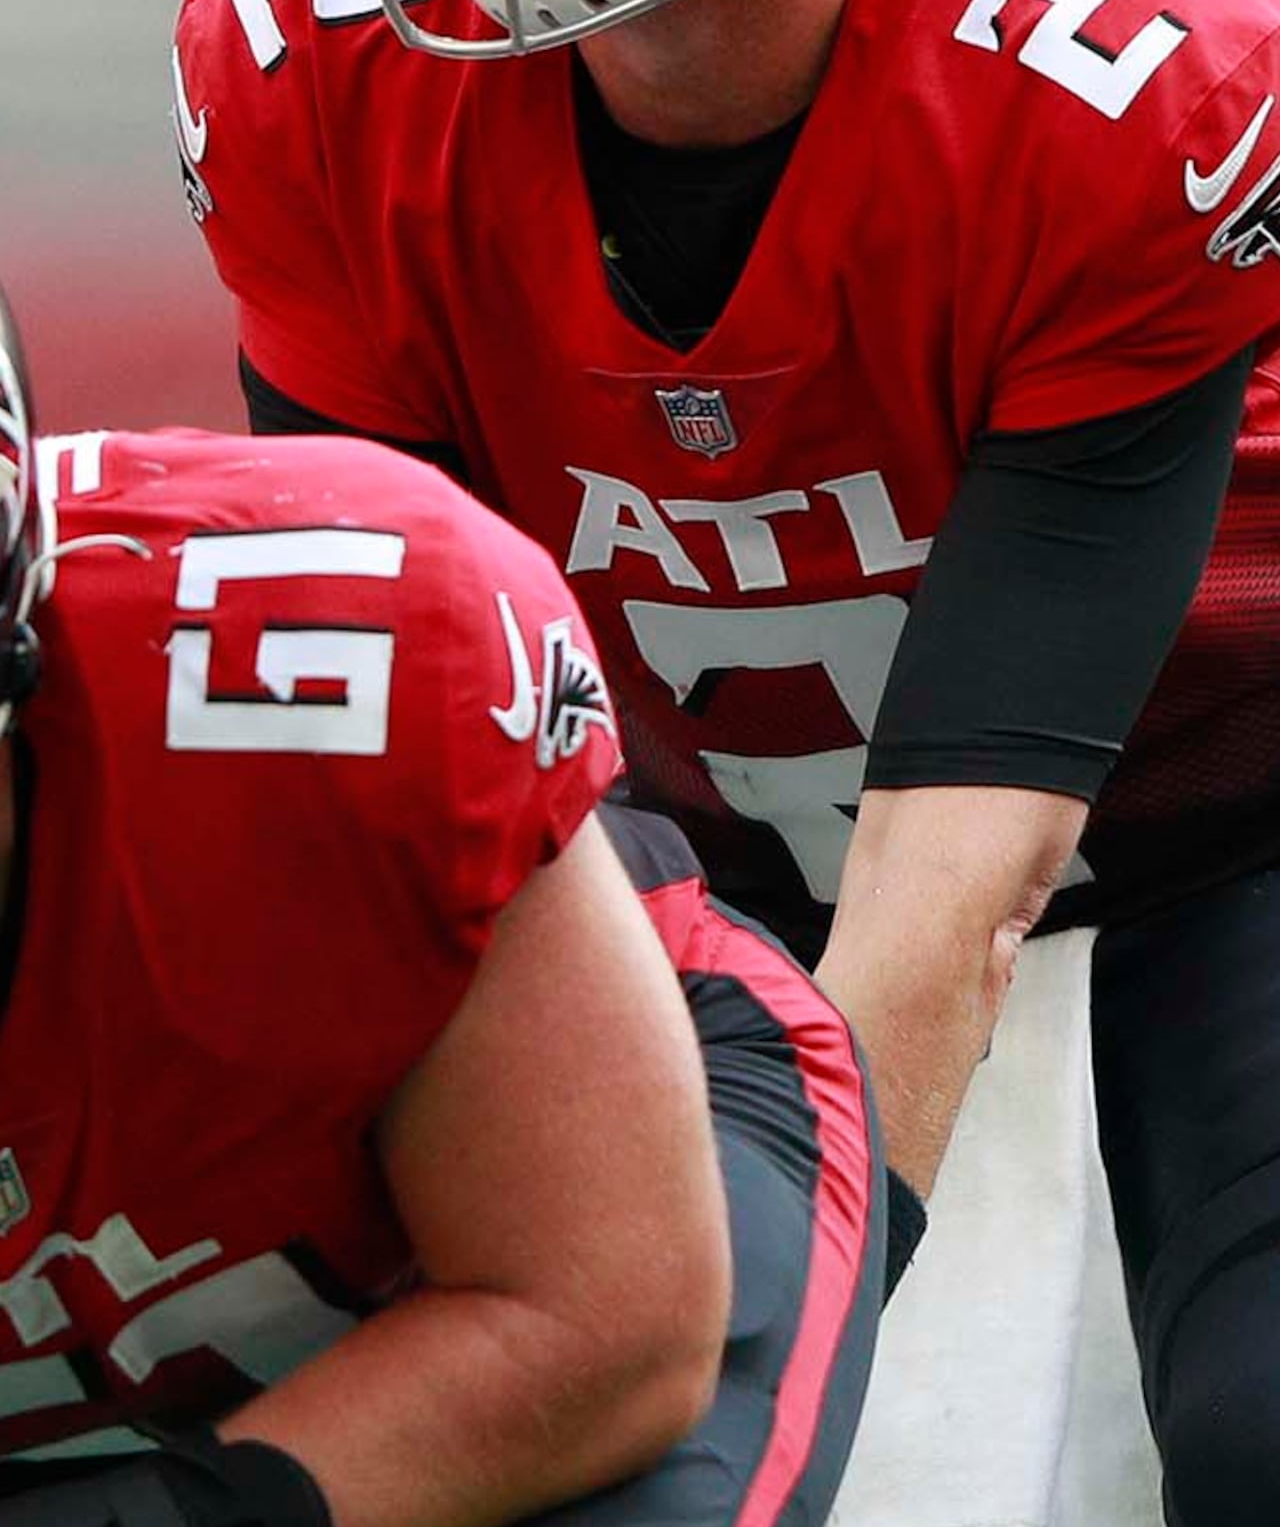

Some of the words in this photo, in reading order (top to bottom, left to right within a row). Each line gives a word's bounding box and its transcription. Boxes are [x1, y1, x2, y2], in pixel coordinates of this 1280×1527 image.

[676, 419, 725, 447] NFL
[565, 466, 936, 592] ATL
[165, 526, 406, 756] 61
